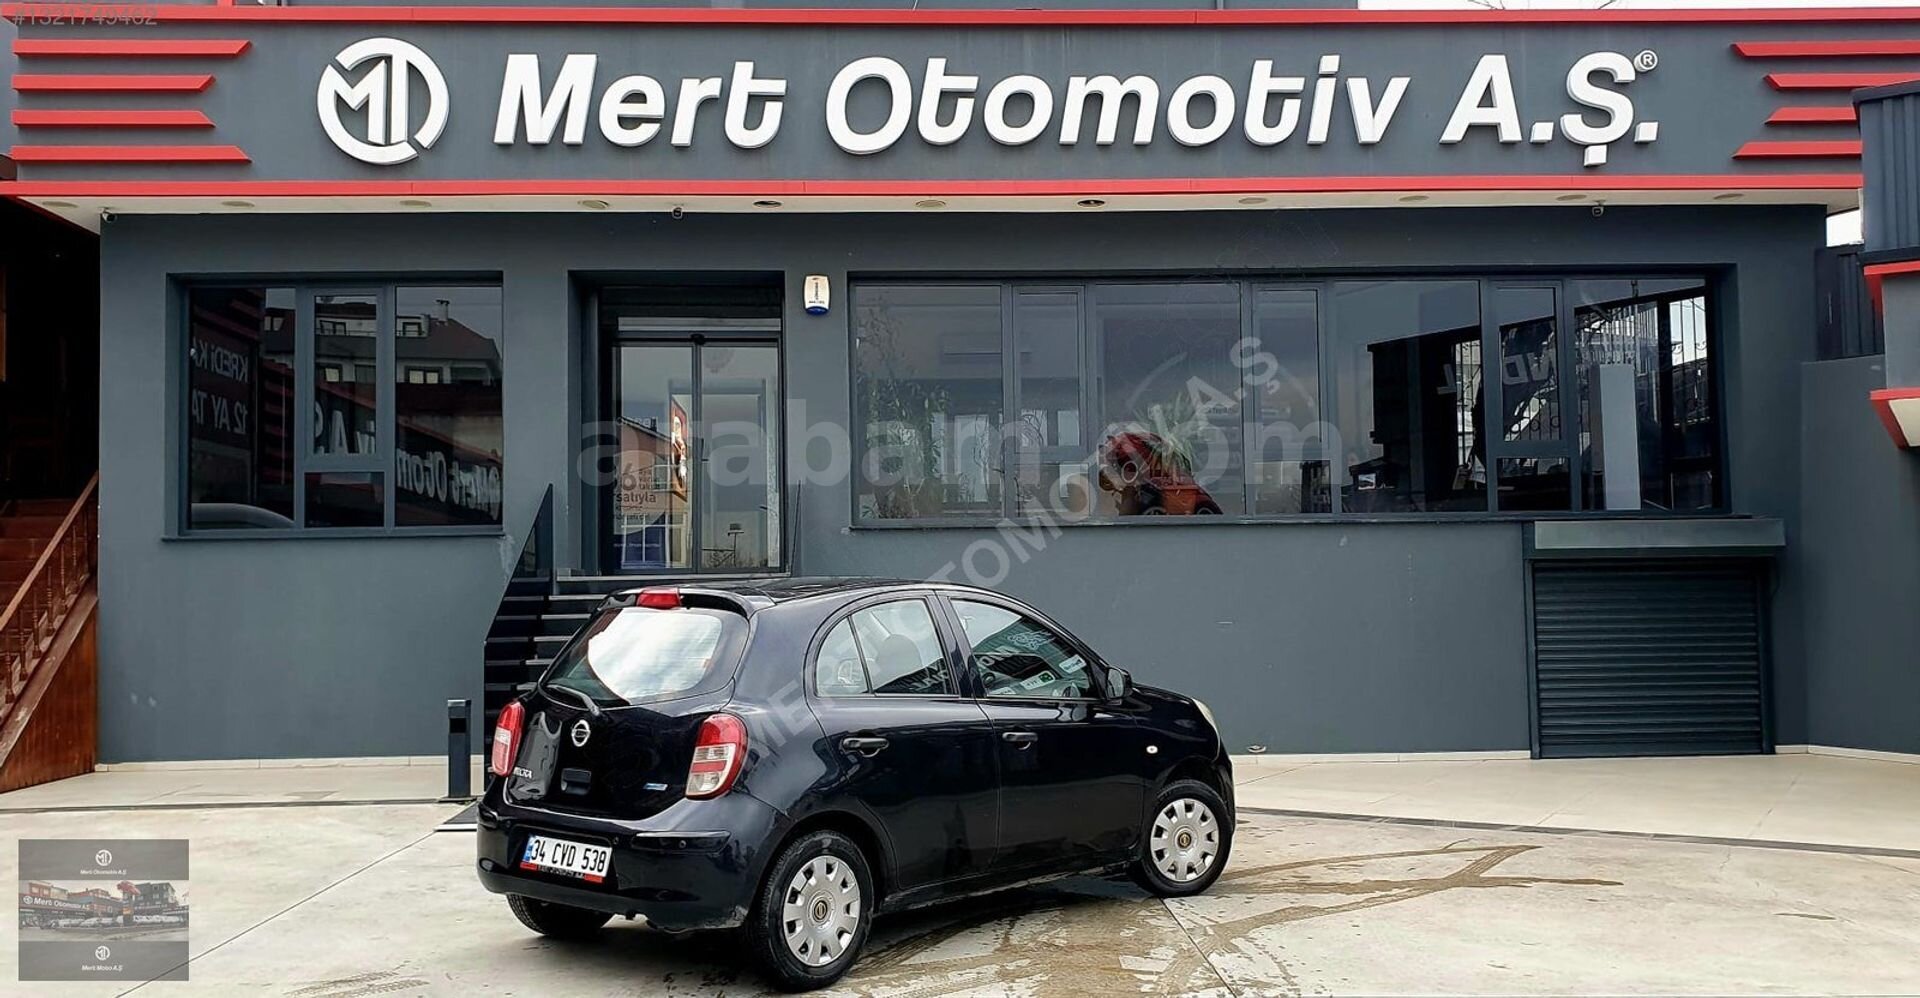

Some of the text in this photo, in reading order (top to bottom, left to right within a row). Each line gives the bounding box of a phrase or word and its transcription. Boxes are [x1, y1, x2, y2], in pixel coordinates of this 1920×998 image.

[493, 53, 787, 149] Mert
[825, 55, 1411, 155] Otomotiv
[531, 839, 546, 862] 34
[552, 843, 576, 867] CVD
[581, 848, 607, 872] 538
